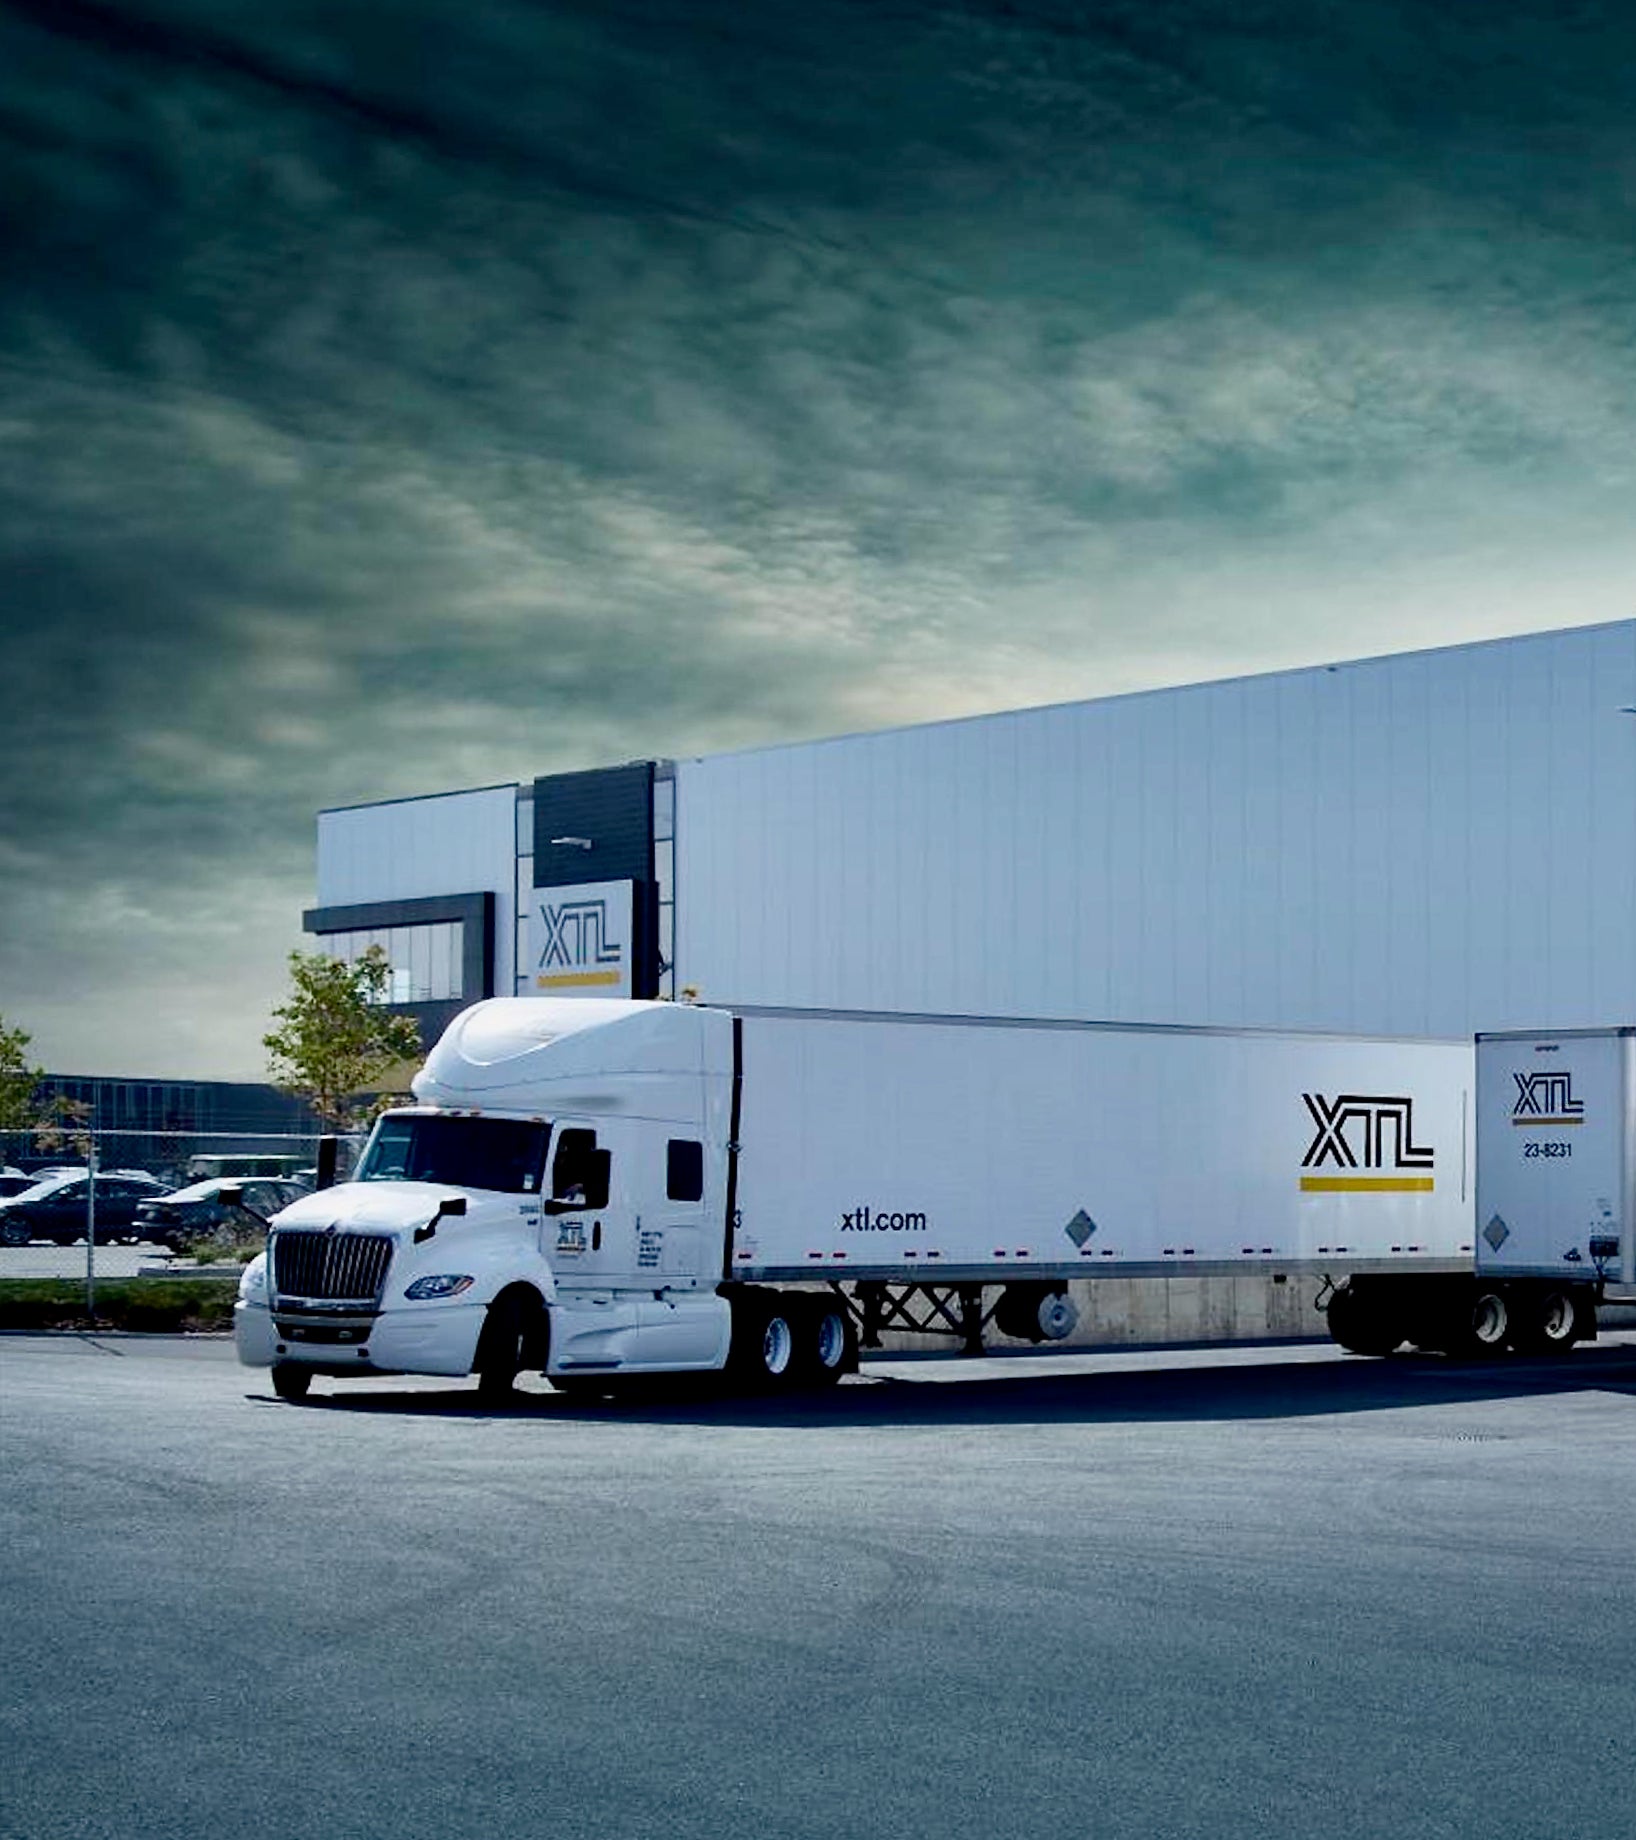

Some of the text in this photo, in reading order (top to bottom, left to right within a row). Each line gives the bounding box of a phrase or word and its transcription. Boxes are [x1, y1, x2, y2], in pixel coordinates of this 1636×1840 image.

[539, 900, 621, 967] XTL
[1513, 1072, 1584, 1114] XTL
[1301, 1093, 1434, 1167] XTL
[841, 1207, 926, 1231] xtl.com
